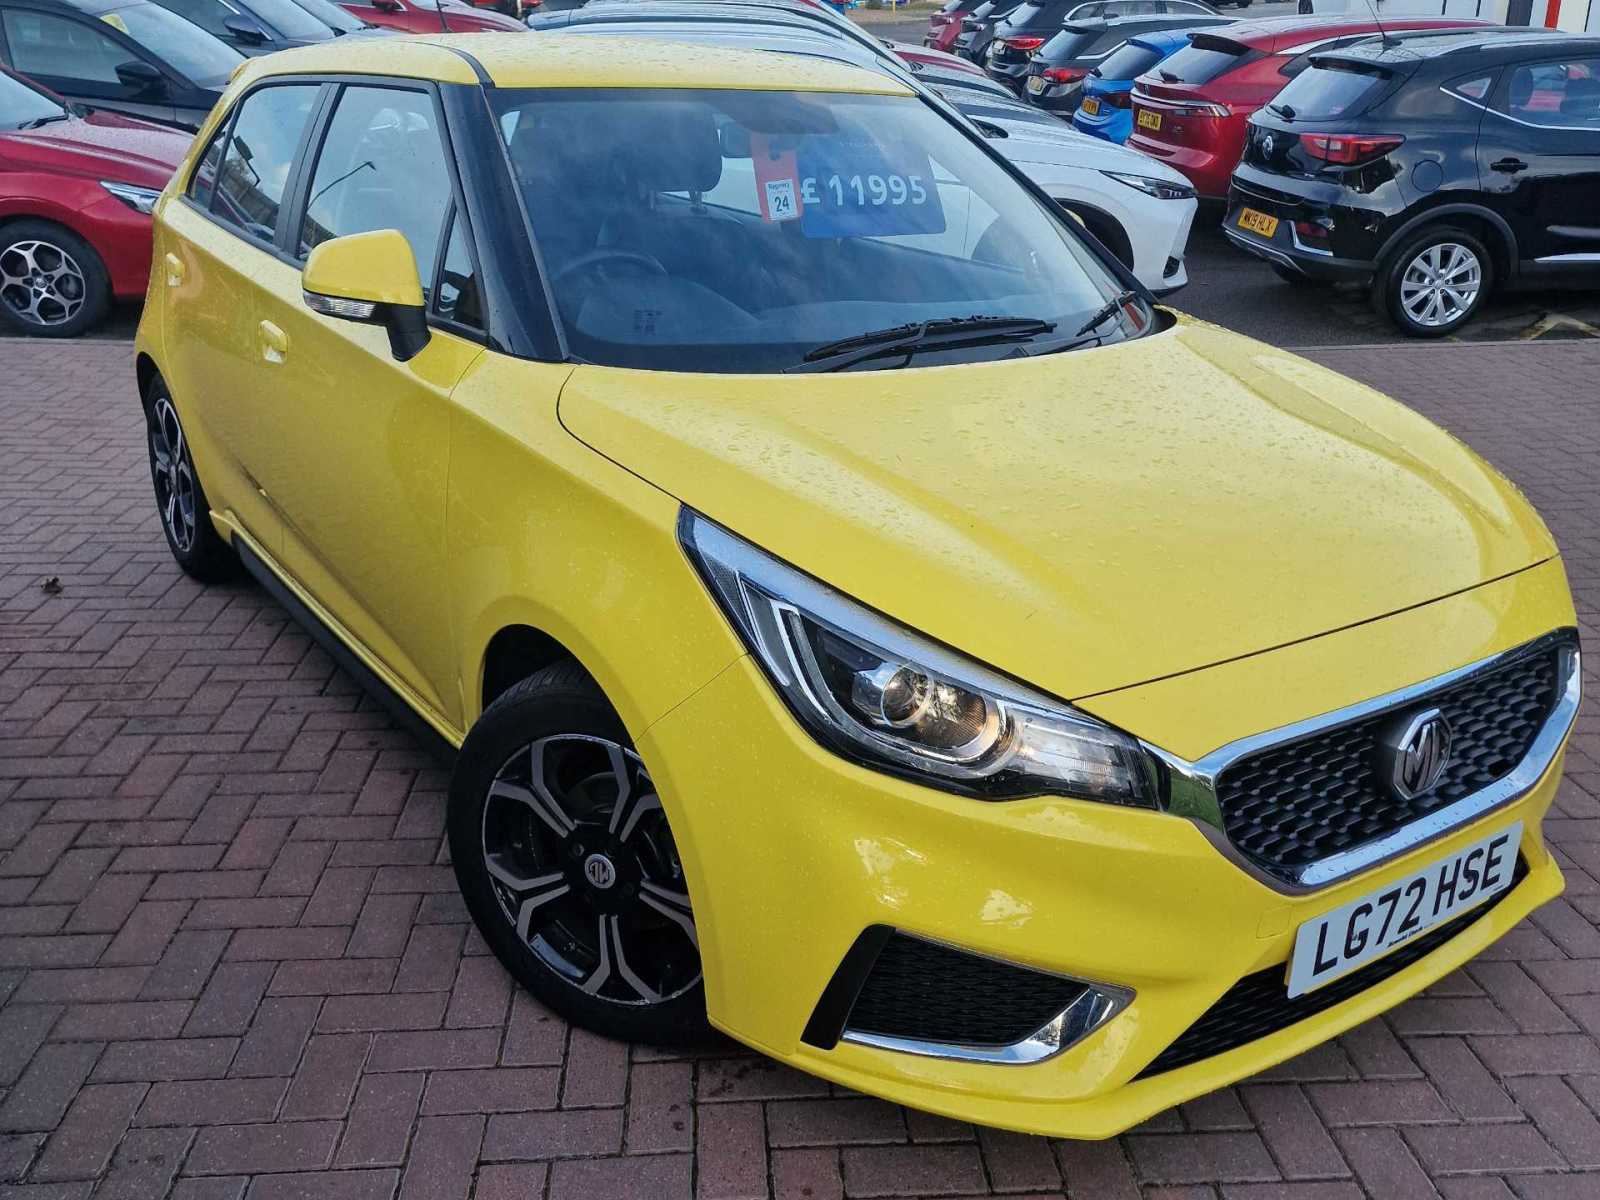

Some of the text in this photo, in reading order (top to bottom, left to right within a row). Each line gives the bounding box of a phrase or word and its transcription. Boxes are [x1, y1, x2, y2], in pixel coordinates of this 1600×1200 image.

[774, 195, 790, 212] 24
[1312, 834, 1509, 976] LG72 HSE
